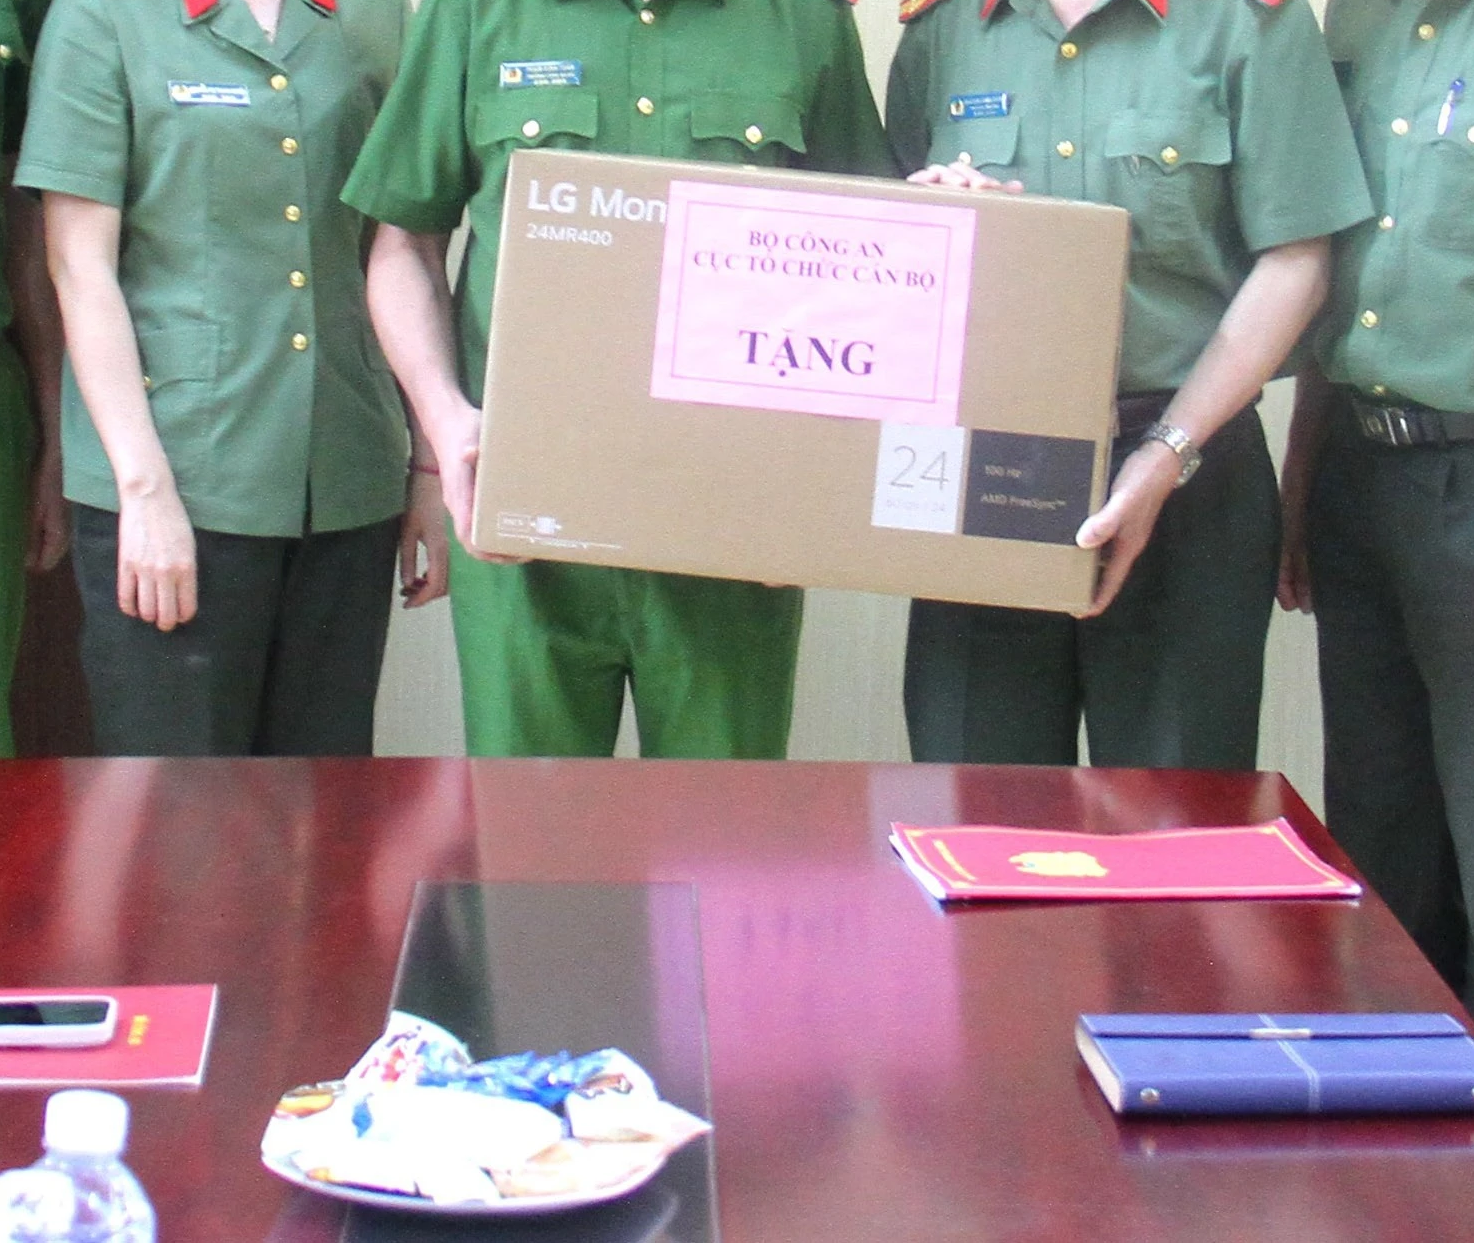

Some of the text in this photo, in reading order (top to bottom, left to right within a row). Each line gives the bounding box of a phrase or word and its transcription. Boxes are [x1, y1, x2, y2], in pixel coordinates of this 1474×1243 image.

[528, 179, 578, 213] LG
[526, 222, 613, 246] 24MR400
[749, 229, 886, 258] BỘ CÔNG AN
[905, 269, 935, 293] BỘ
[738, 327, 876, 377] TẶNG
[889, 444, 949, 490] 24
